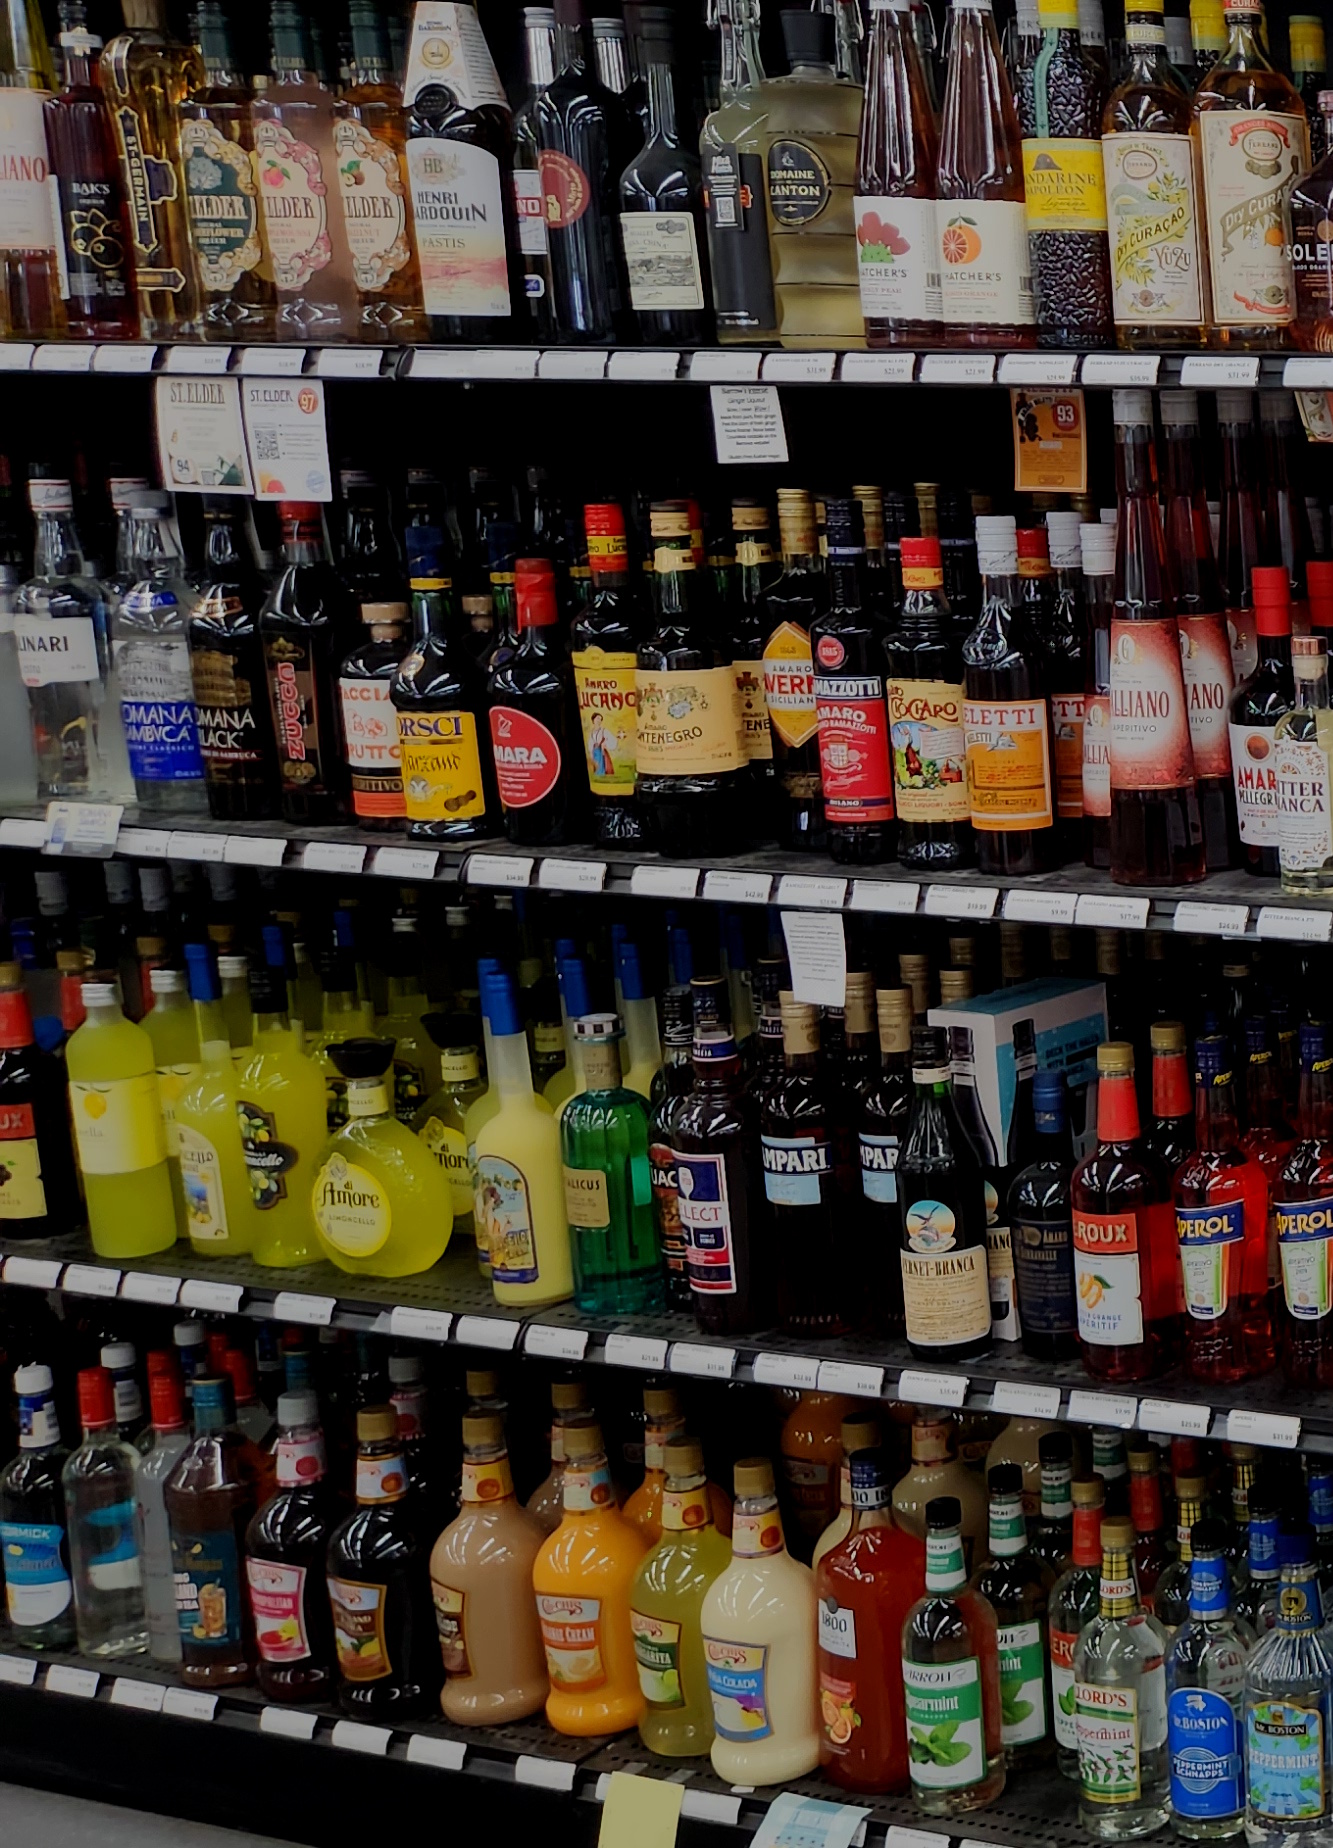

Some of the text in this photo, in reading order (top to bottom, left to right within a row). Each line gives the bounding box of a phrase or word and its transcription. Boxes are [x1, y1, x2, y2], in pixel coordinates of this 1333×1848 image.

[126, 134, 150, 236] ST-GERMAIN
[417, 191, 458, 208] HENRI
[1130, 206, 1185, 241] CURAÇAO
[421, 236, 466, 249] PASTIS
[300, 393, 315, 411] 97
[1056, 405, 1075, 423] 93
[177, 458, 190, 474] 94
[586, 678, 617, 690] AMARO
[579, 691, 636, 710] LUCANO
[816, 706, 867, 722] AMARO
[343, 1180, 354, 1190] di
[320, 1182, 380, 1210] Amore
[329, 1214, 376, 1226] LIMONCELLO
[1176, 1213, 1234, 1239] APEROL
[821, 1611, 848, 1632] 1800
[1075, 1683, 1127, 1707] LORD'S
[1272, 1724, 1305, 1734] BOSTON
[1173, 1760, 1229, 1771] PEPPERMINT
[1249, 1752, 1318, 1768] PEPPERMINT
[1175, 1769, 1224, 1778] SCHNAPPS
